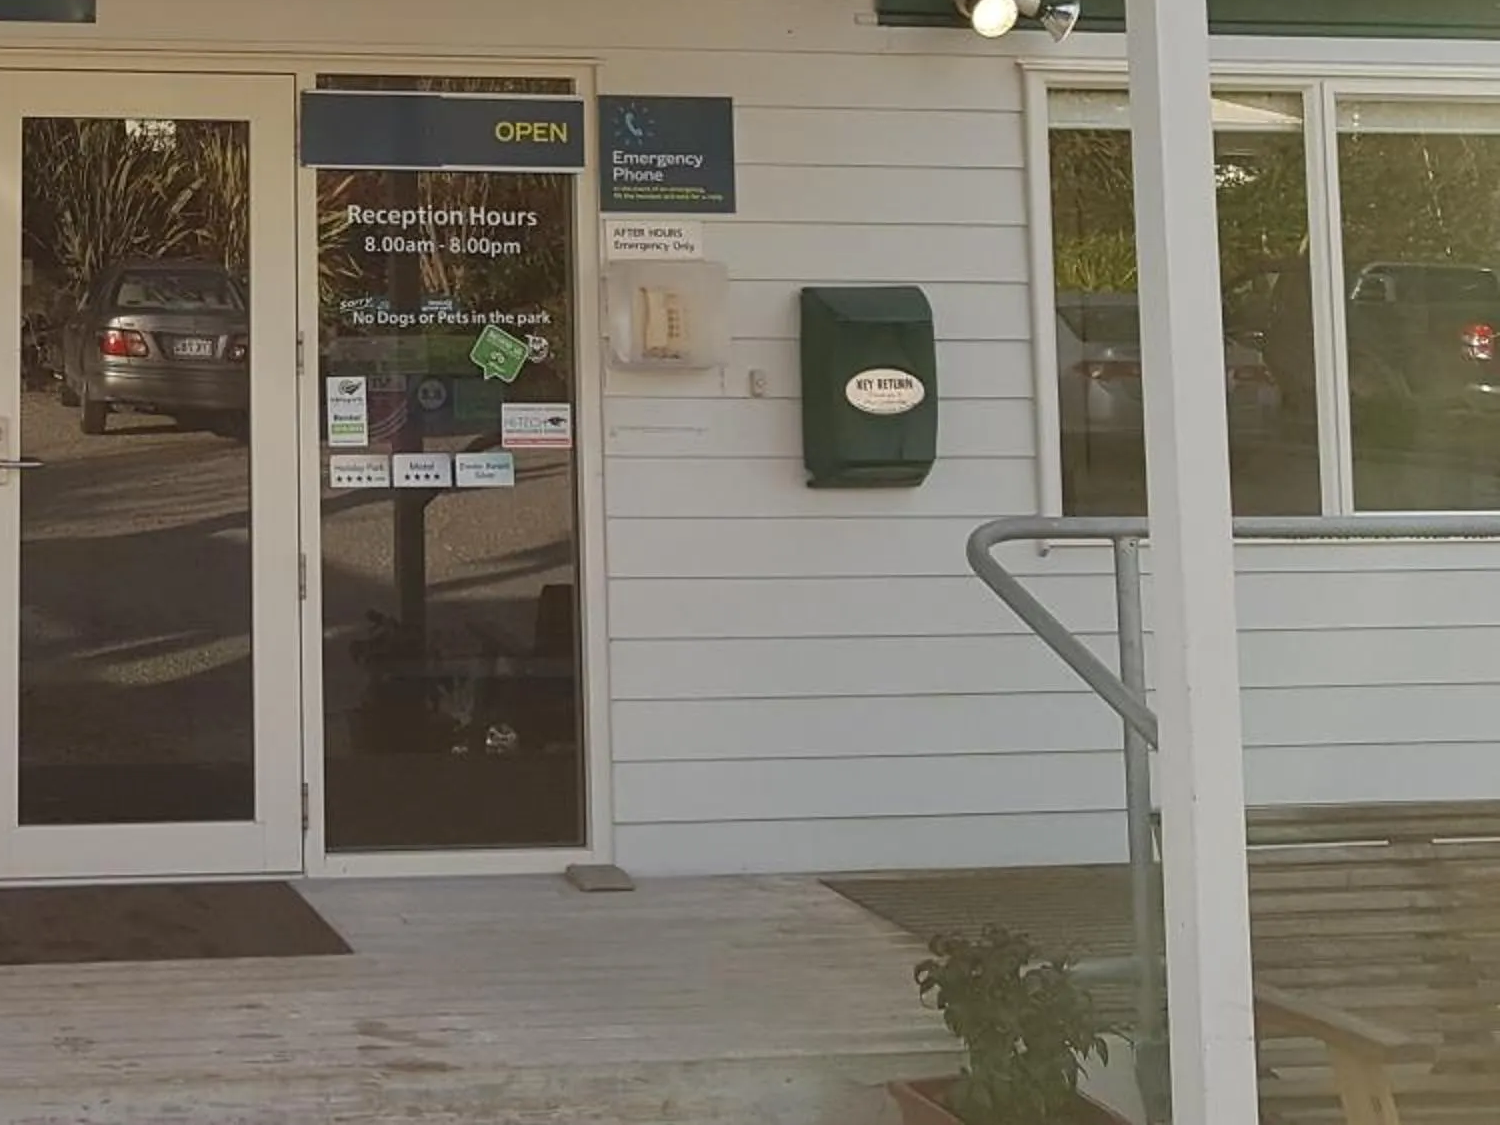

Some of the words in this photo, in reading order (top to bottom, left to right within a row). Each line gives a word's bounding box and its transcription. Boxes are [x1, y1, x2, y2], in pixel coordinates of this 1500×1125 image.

[495, 121, 568, 144] OPEN
[612, 150, 704, 169] Emergency
[612, 166, 665, 183] Phone
[347, 204, 464, 230] Reception
[469, 206, 539, 227] Hours
[364, 236, 435, 253] 8.00am
[449, 238, 522, 259] 8.00pm
[613, 240, 671, 253] Emergency
[353, 310, 375, 325] No
[377, 310, 417, 328] Dogs
[418, 313, 434, 324] or
[437, 310, 470, 324] Pets
[471, 310, 487, 324] in
[488, 309, 515, 324] the
[517, 310, 552, 328] park
